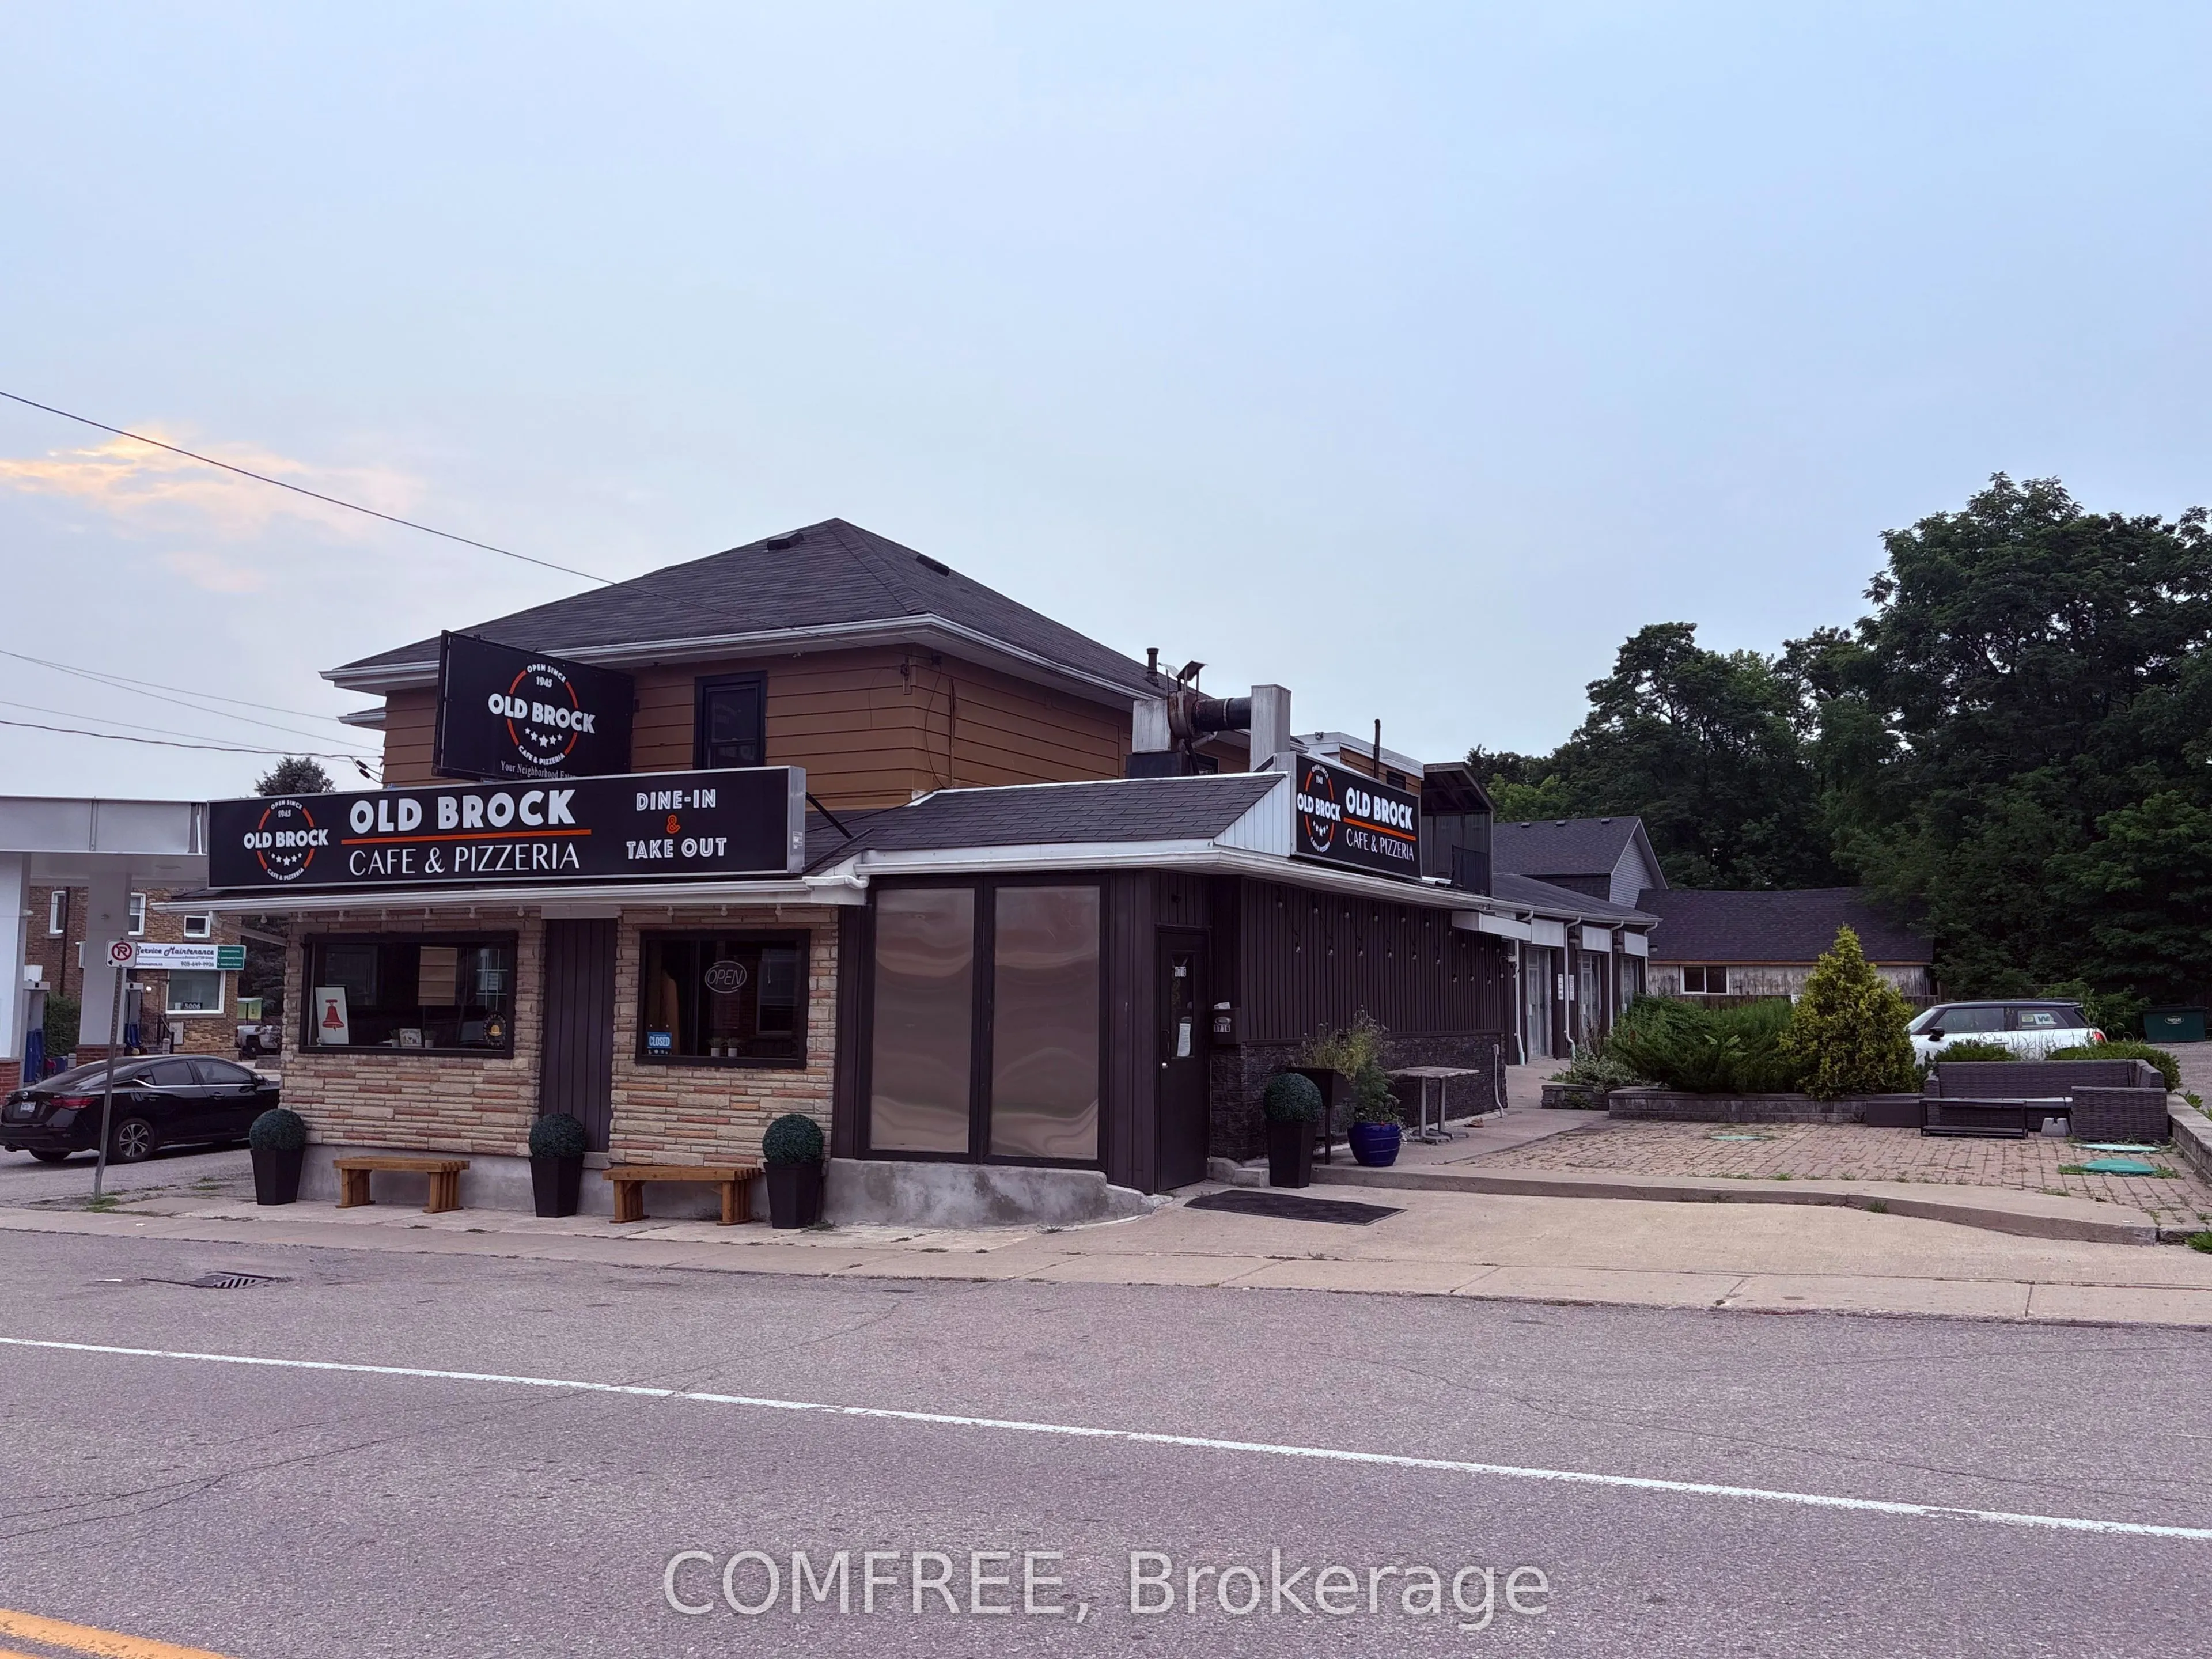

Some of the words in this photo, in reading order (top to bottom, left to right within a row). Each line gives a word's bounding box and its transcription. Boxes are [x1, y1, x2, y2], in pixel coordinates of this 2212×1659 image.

[527, 664, 546, 673] OPEN
[547, 666, 566, 683] SINCE
[536, 676, 553, 688] 1945
[488, 693, 528, 719] OLD
[532, 702, 596, 734] BROCK
[518, 745, 533, 761] CAFE
[539, 752, 565, 766] PIZZERIA
[501, 760, 516, 772] Your
[517, 763, 558, 778] Neighborhood
[271, 800, 286, 810] OPEN
[286, 800, 302, 810] SINCE
[636, 789, 716, 812] DINE-IN
[1297, 792, 1314, 813] OLD
[1315, 797, 1341, 822] BROCK
[1346, 787, 1371, 818] OLD
[1373, 795, 1413, 831] BROCK
[350, 800, 422, 834] OLD
[438, 789, 576, 830] BROCK
[666, 815, 681, 834] &
[243, 832, 272, 849] OLD
[276, 830, 329, 847] BROCK
[626, 839, 674, 859] TAKE
[681, 837, 727, 858] OUT
[1346, 828, 1369, 851] CAFE
[1371, 835, 1378, 853] &
[1380, 836, 1415, 861] PIZZERIA
[349, 848, 416, 876] CAFE
[425, 847, 445, 874] &
[454, 842, 580, 872] PIZZERIA
[267, 868, 279, 880] CAFE
[136, 945, 162, 956] Service
[164, 946, 214, 956] Maintenance
[707, 969, 743, 985] OPEN
[184, 1002, 201, 1010] 5006
[649, 1036, 671, 1047] CLOSED
